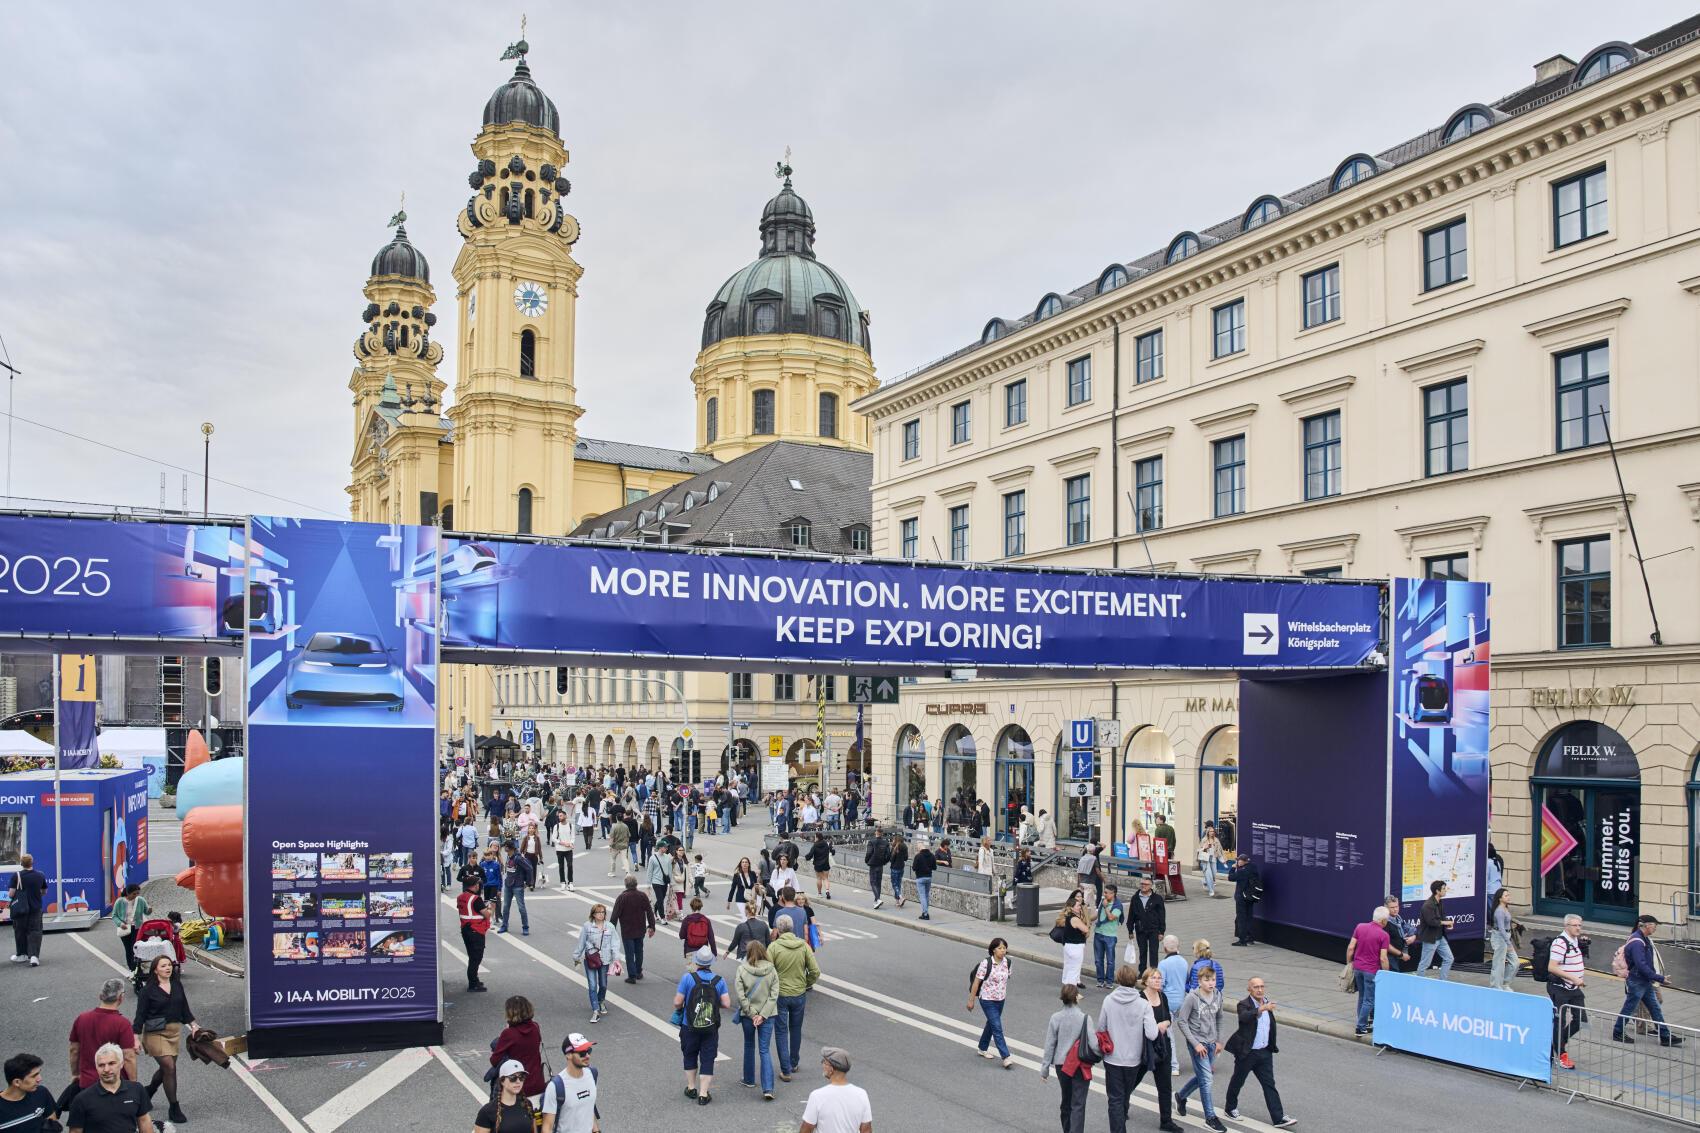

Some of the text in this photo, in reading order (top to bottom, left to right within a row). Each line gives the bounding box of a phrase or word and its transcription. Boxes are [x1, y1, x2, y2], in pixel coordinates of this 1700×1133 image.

[590, 566, 1187, 618] MORE INNOVATION. MORE EXCITEMENT.
[776, 615, 1042, 650] KEEP EXPLORING!
[1288, 621, 1372, 635] Wittelsbacherplatz
[1288, 637, 1340, 650] Königsplatz
[1185, 697, 1239, 712] MR MA
[1530, 687, 1600, 707] FELIX
[525, 721, 532, 729] U
[1076, 724, 1089, 744] U
[1563, 745, 1617, 757] FELIX W.
[0, 795, 35, 805] POINT
[272, 840, 369, 850] Open Space Highlights
[1601, 815, 1614, 890] summer.
[1615, 807, 1634, 892] suits you.
[1456, 914, 1475, 924] 2025
[287, 986, 416, 1003] IAA MOBILITY 2025
[1407, 1004, 1530, 1045] IAA MOBILITY
